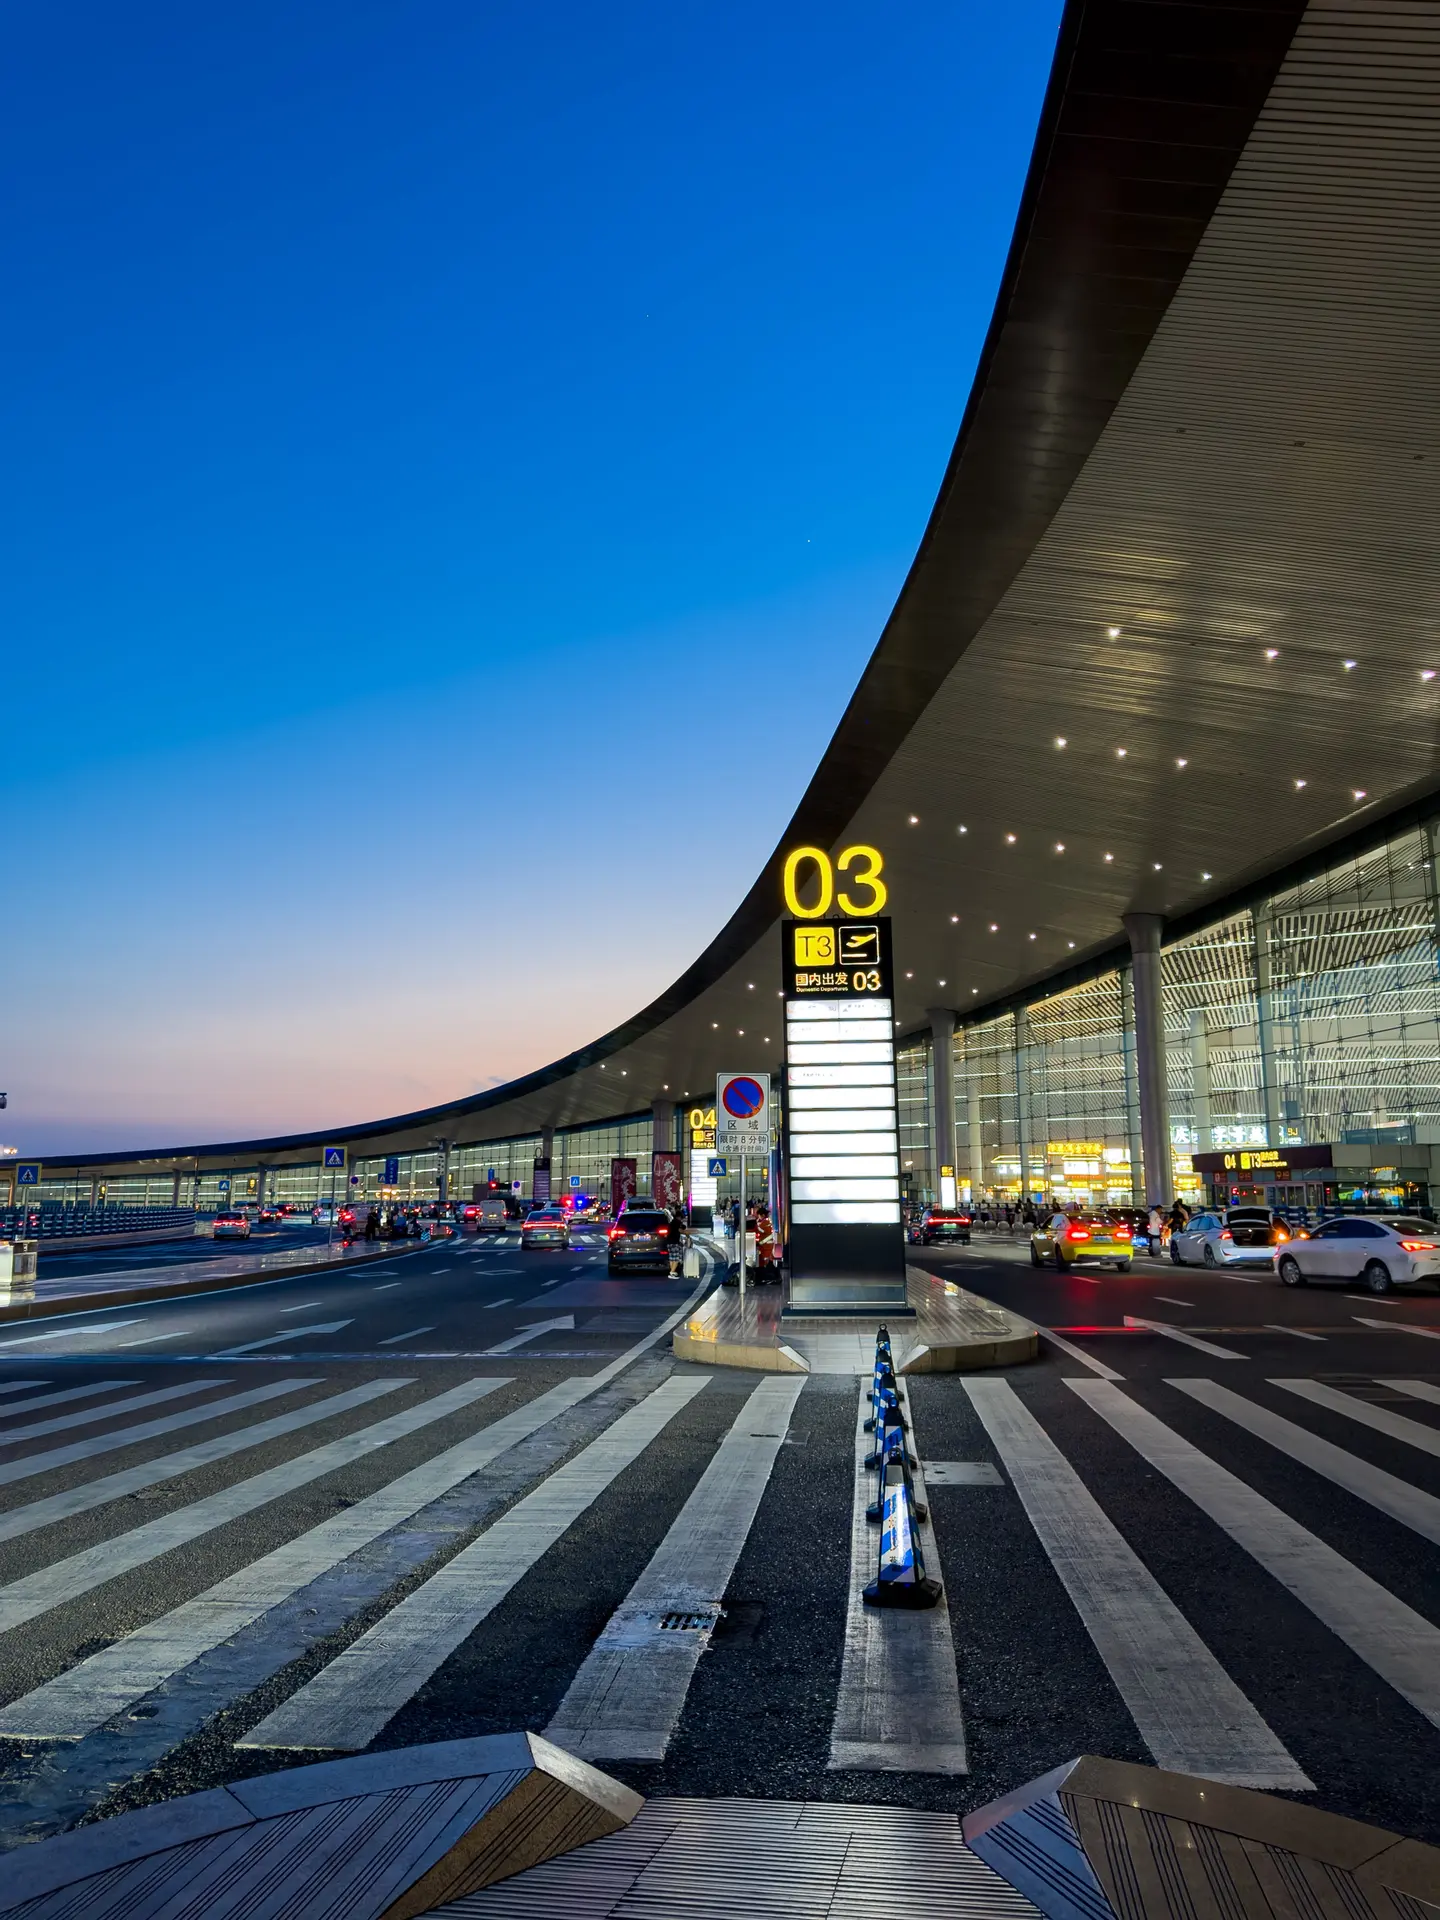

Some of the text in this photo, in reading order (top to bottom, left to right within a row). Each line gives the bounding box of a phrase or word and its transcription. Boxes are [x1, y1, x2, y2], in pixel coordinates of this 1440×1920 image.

[784, 846, 887, 919] 03
[798, 936, 832, 957] T3
[796, 970, 881, 991] 国内出发 03
[690, 1109, 717, 1129] 04
[1224, 1154, 1237, 1170] 04
[1250, 1153, 1261, 1168] T3
